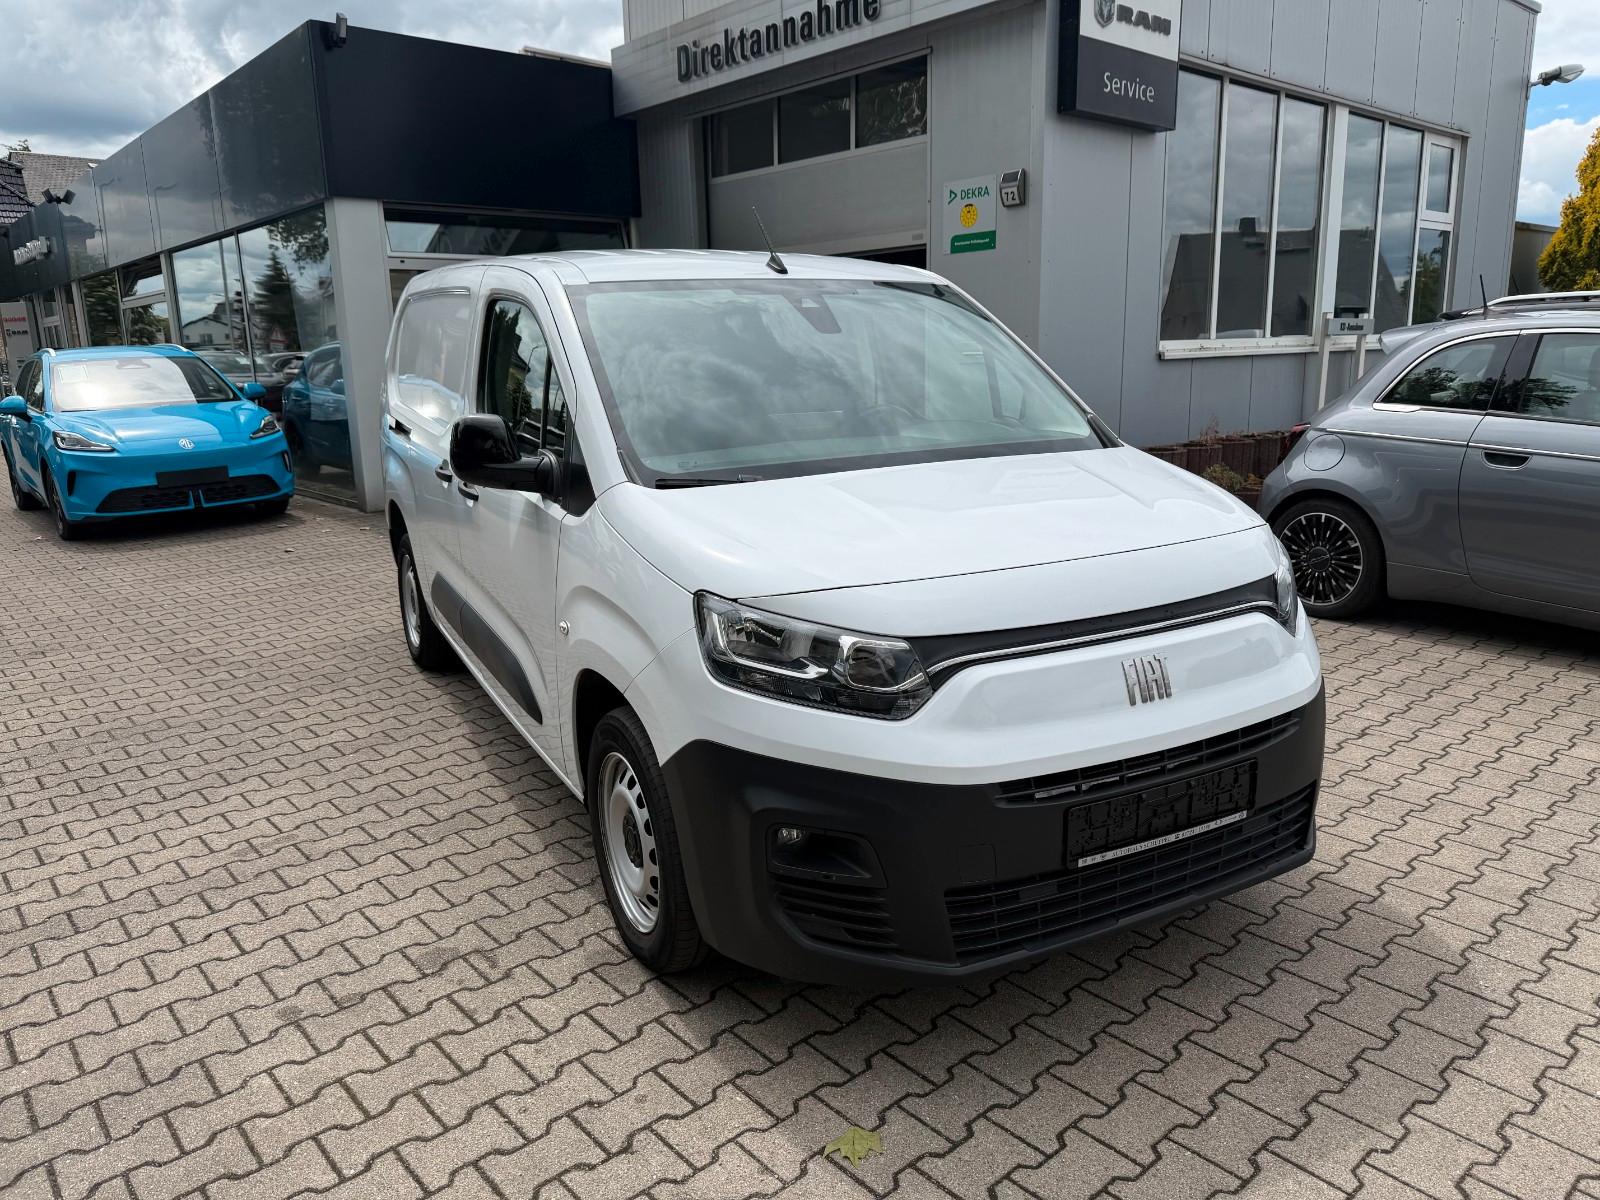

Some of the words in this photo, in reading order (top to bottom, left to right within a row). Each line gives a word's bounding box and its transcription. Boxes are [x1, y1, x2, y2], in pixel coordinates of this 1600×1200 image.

[1116, 3, 1172, 36] RAM
[676, 0, 881, 83] Direktannahme
[1103, 71, 1155, 103] Service
[960, 186, 990, 200] DEKRA
[1004, 191, 1016, 202] 72
[1121, 655, 1172, 706] FIAT
